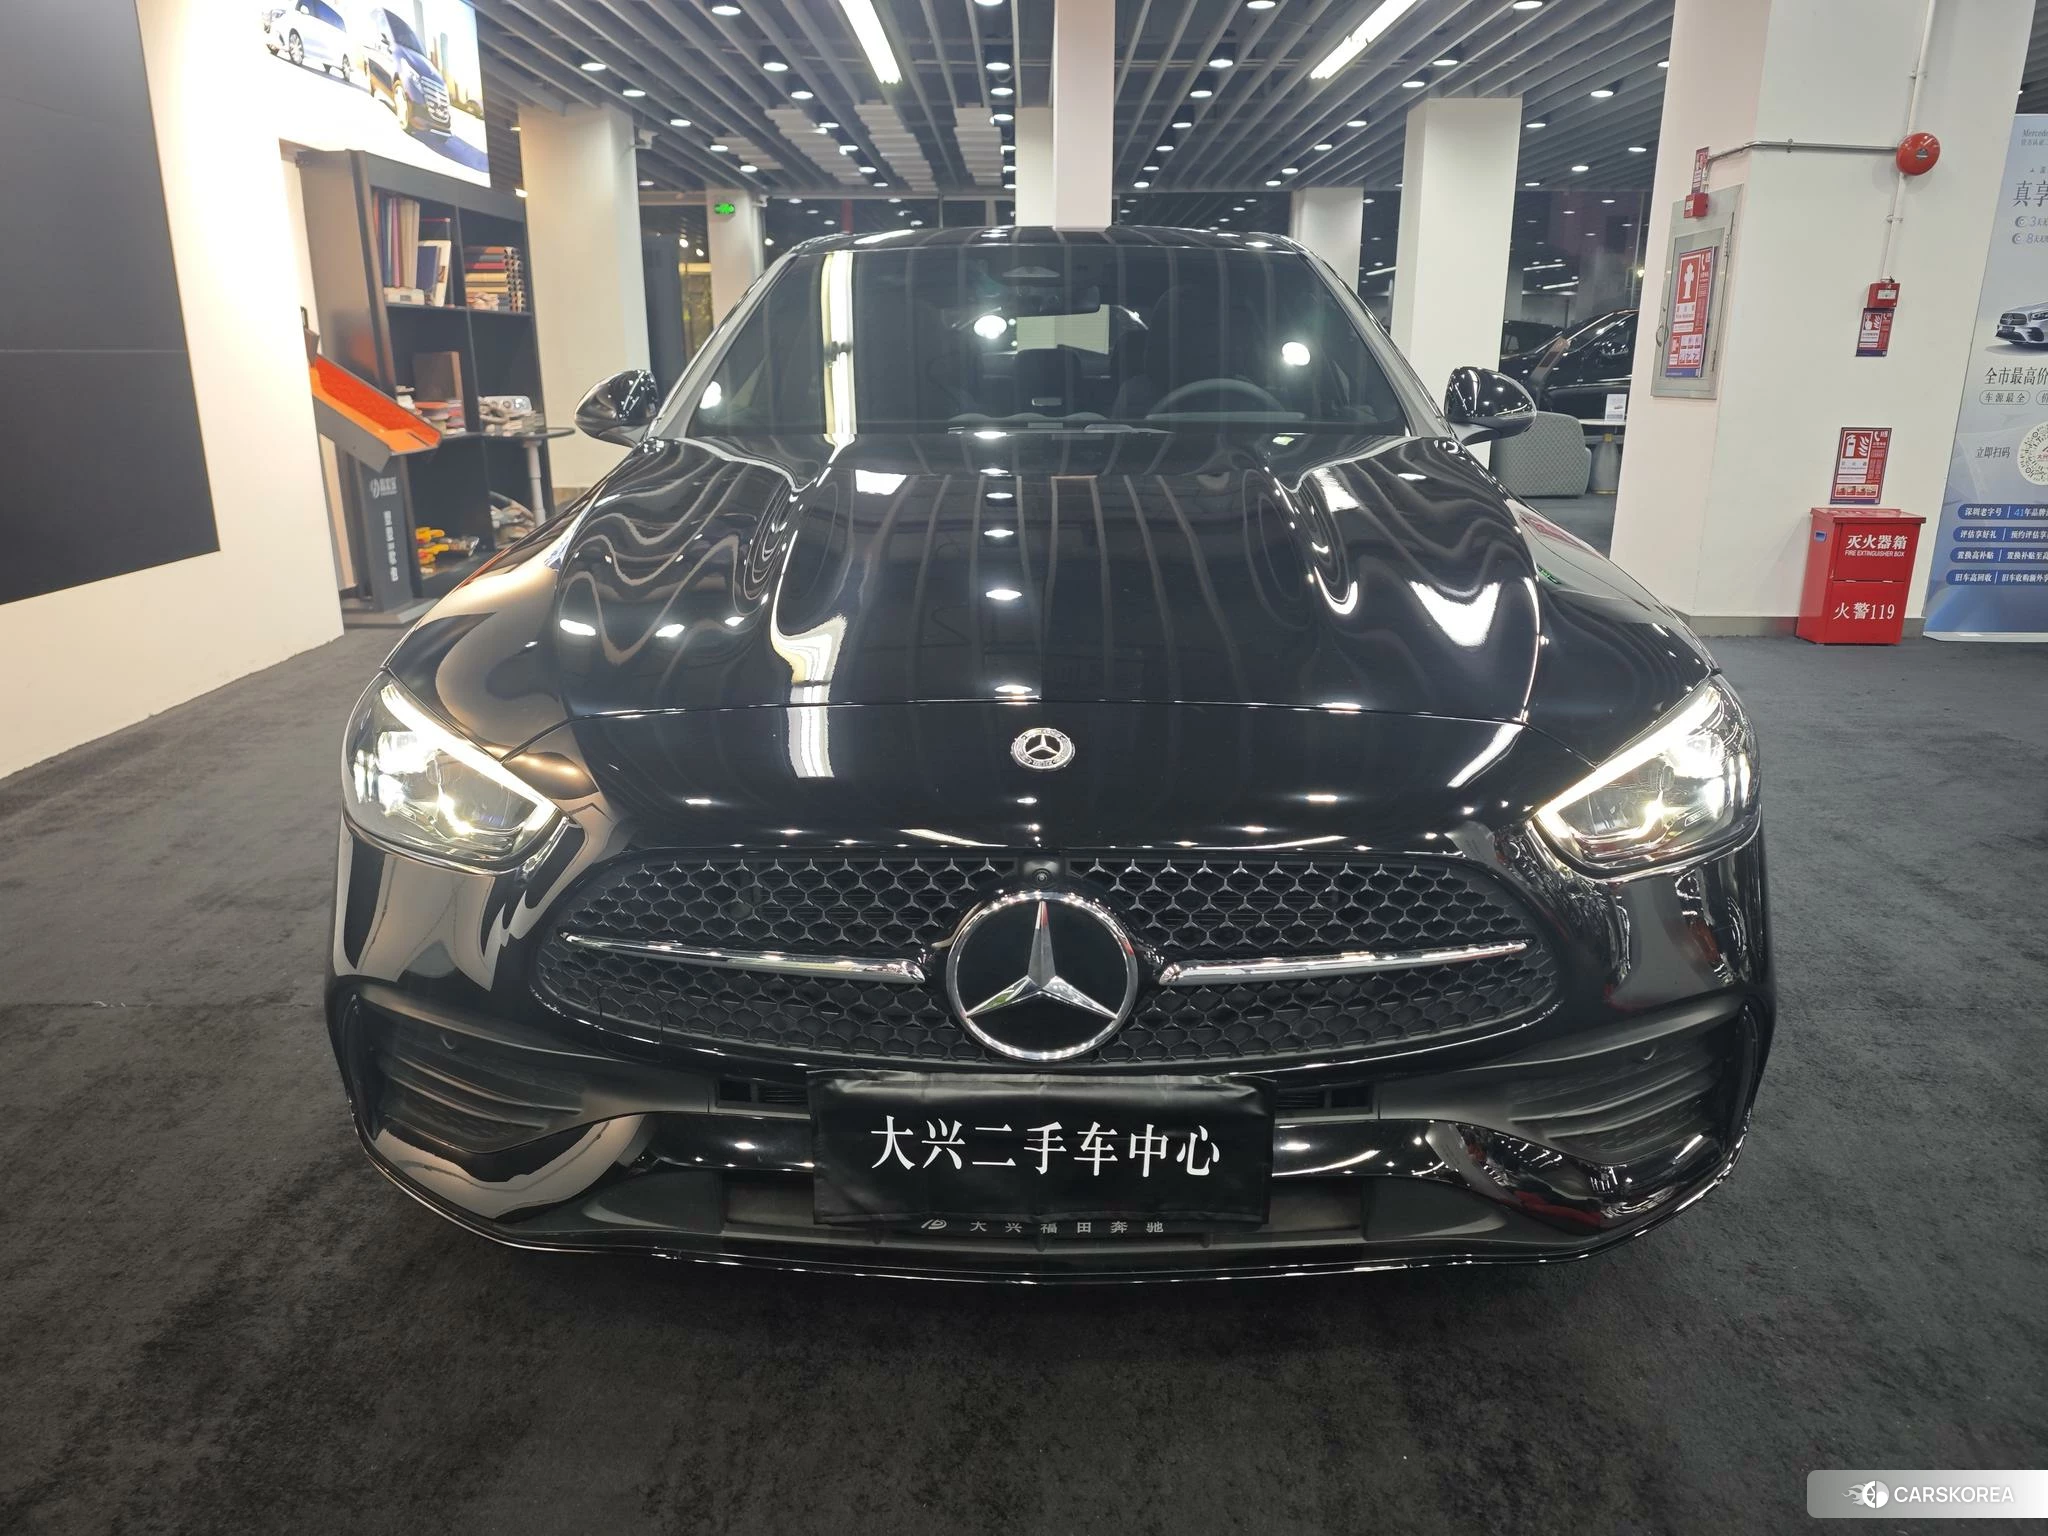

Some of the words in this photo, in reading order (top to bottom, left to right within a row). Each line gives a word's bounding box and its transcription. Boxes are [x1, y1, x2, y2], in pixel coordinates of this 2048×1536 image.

[1975, 446, 2011, 459] 立即扫码
[1965, 507, 2002, 517] 深圳老字号
[1846, 534, 1908, 549] 灭火器箱
[1844, 549, 1857, 557] FIRE
[1857, 549, 1894, 557] EXTINGUISHER
[870, 1115, 1221, 1178] 大兴二手车中心
[969, 1220, 1165, 1235] 大兴福田奔驰
